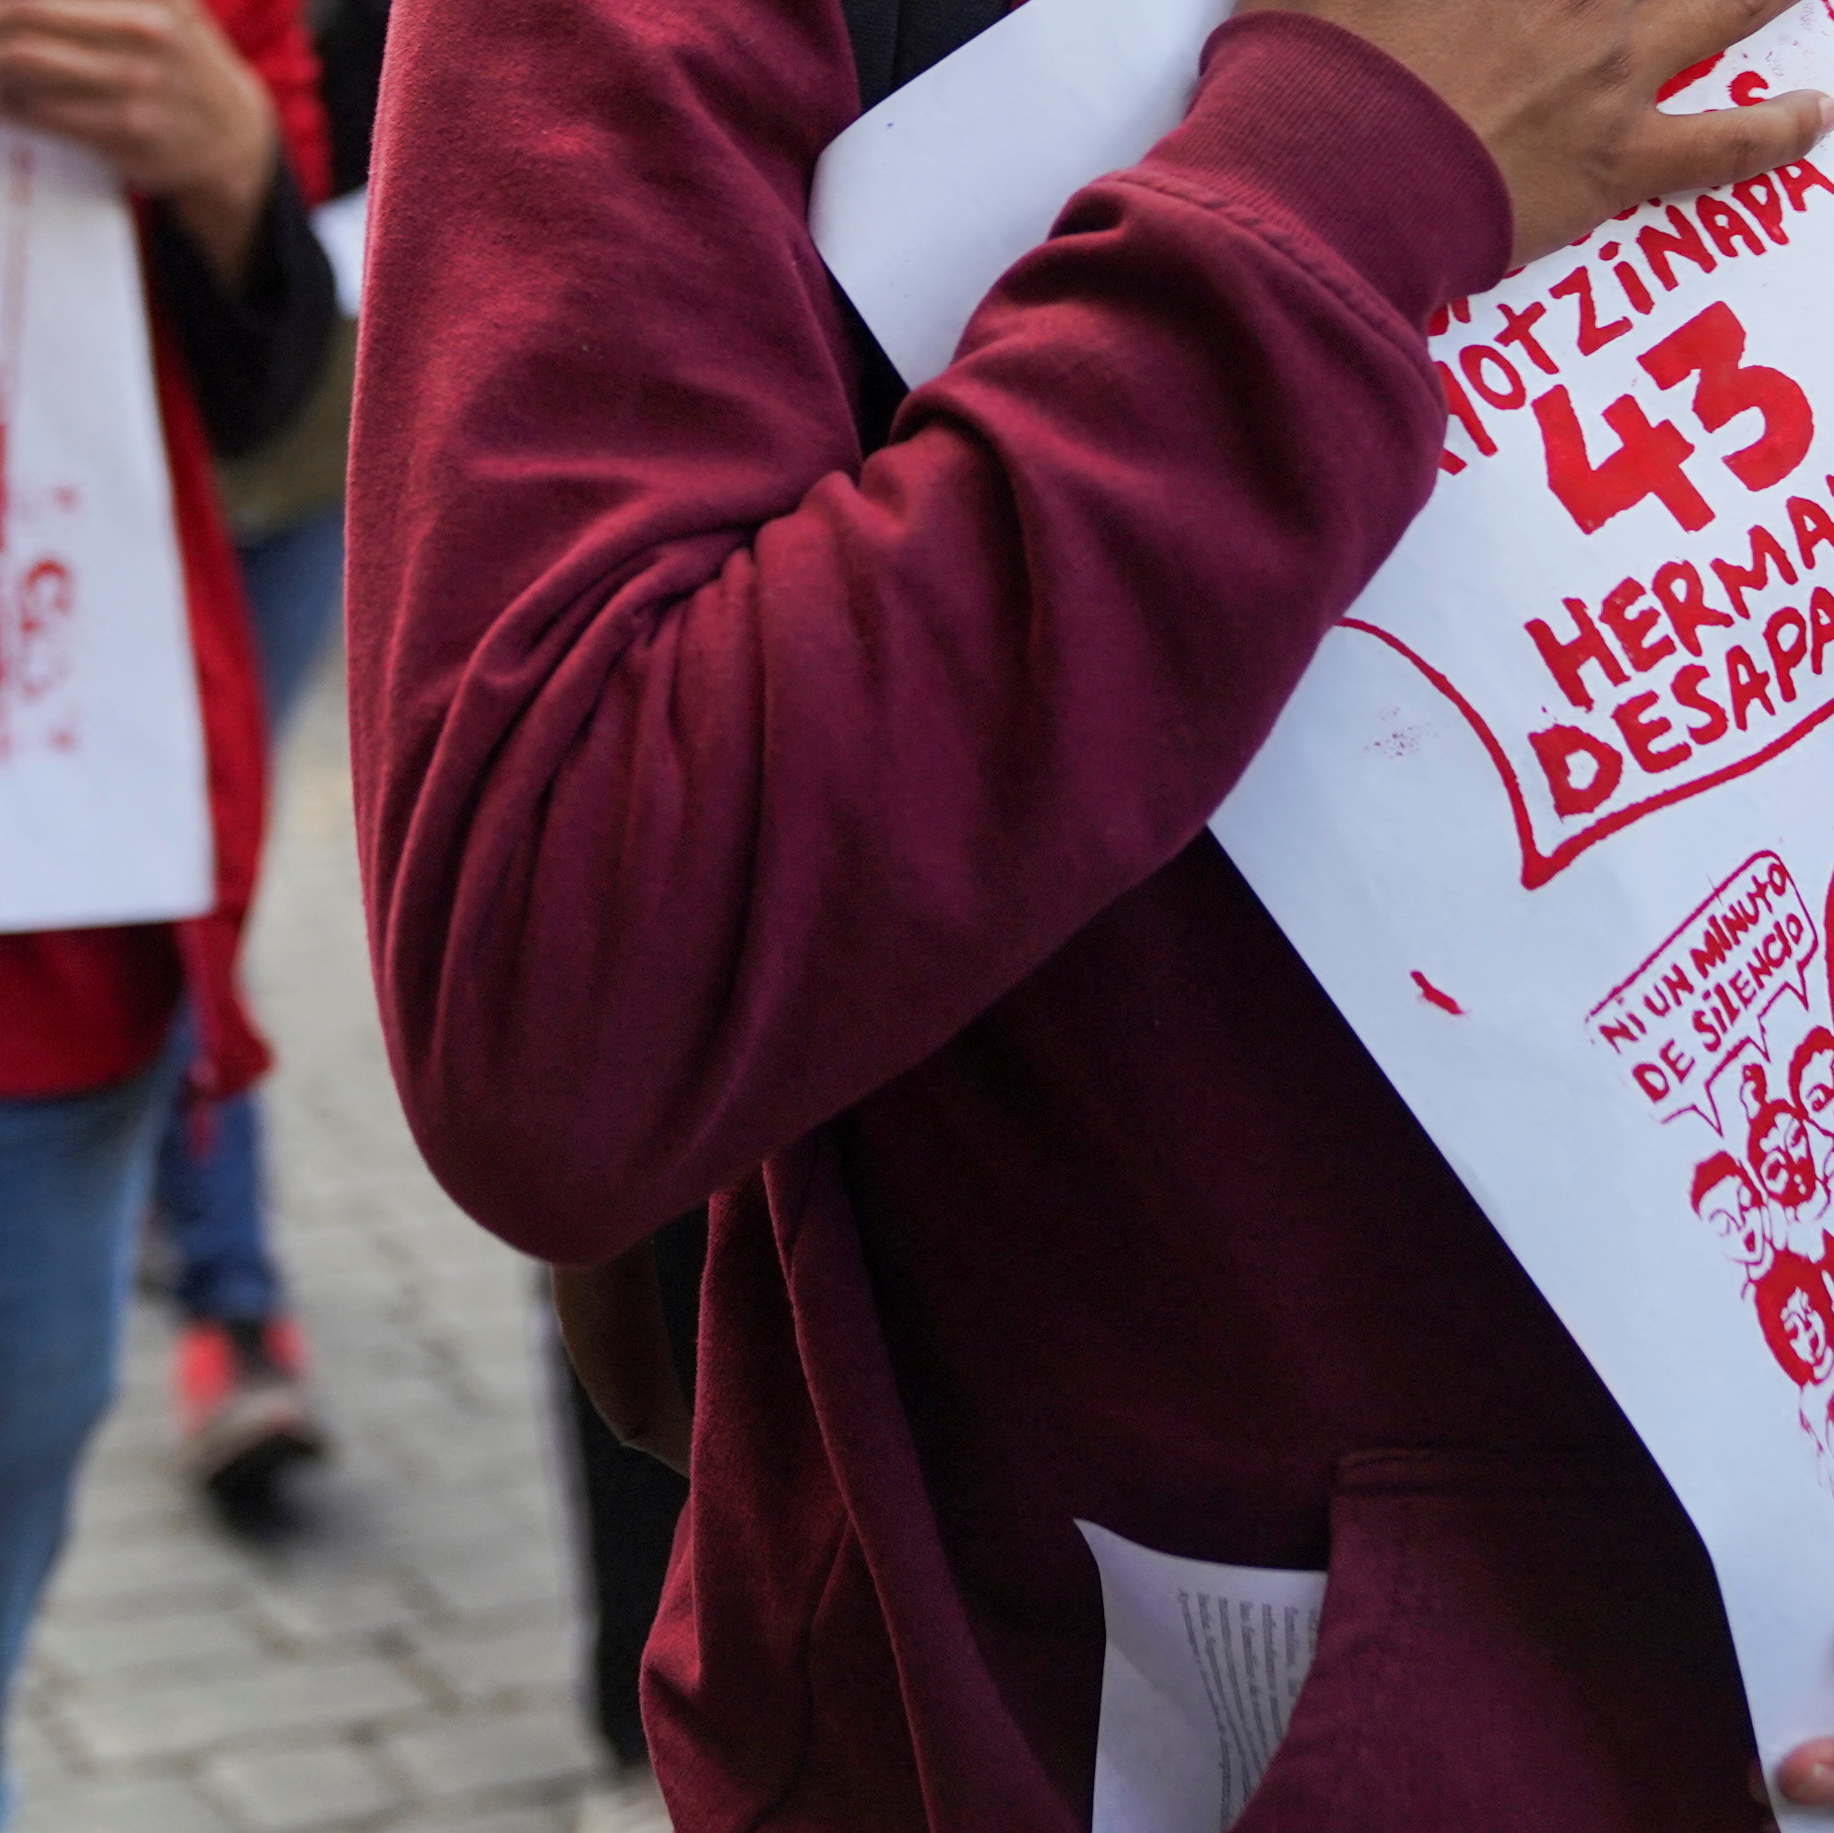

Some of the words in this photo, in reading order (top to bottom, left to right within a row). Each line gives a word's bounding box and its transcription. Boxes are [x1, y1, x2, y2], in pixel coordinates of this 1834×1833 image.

[1530, 300, 1816, 536] 43
[1598, 997, 1647, 1054] NI
[1643, 962, 1695, 1017] UN
[1631, 1038, 1696, 1104] DE
[1691, 913, 1805, 1053] SILENCIO
